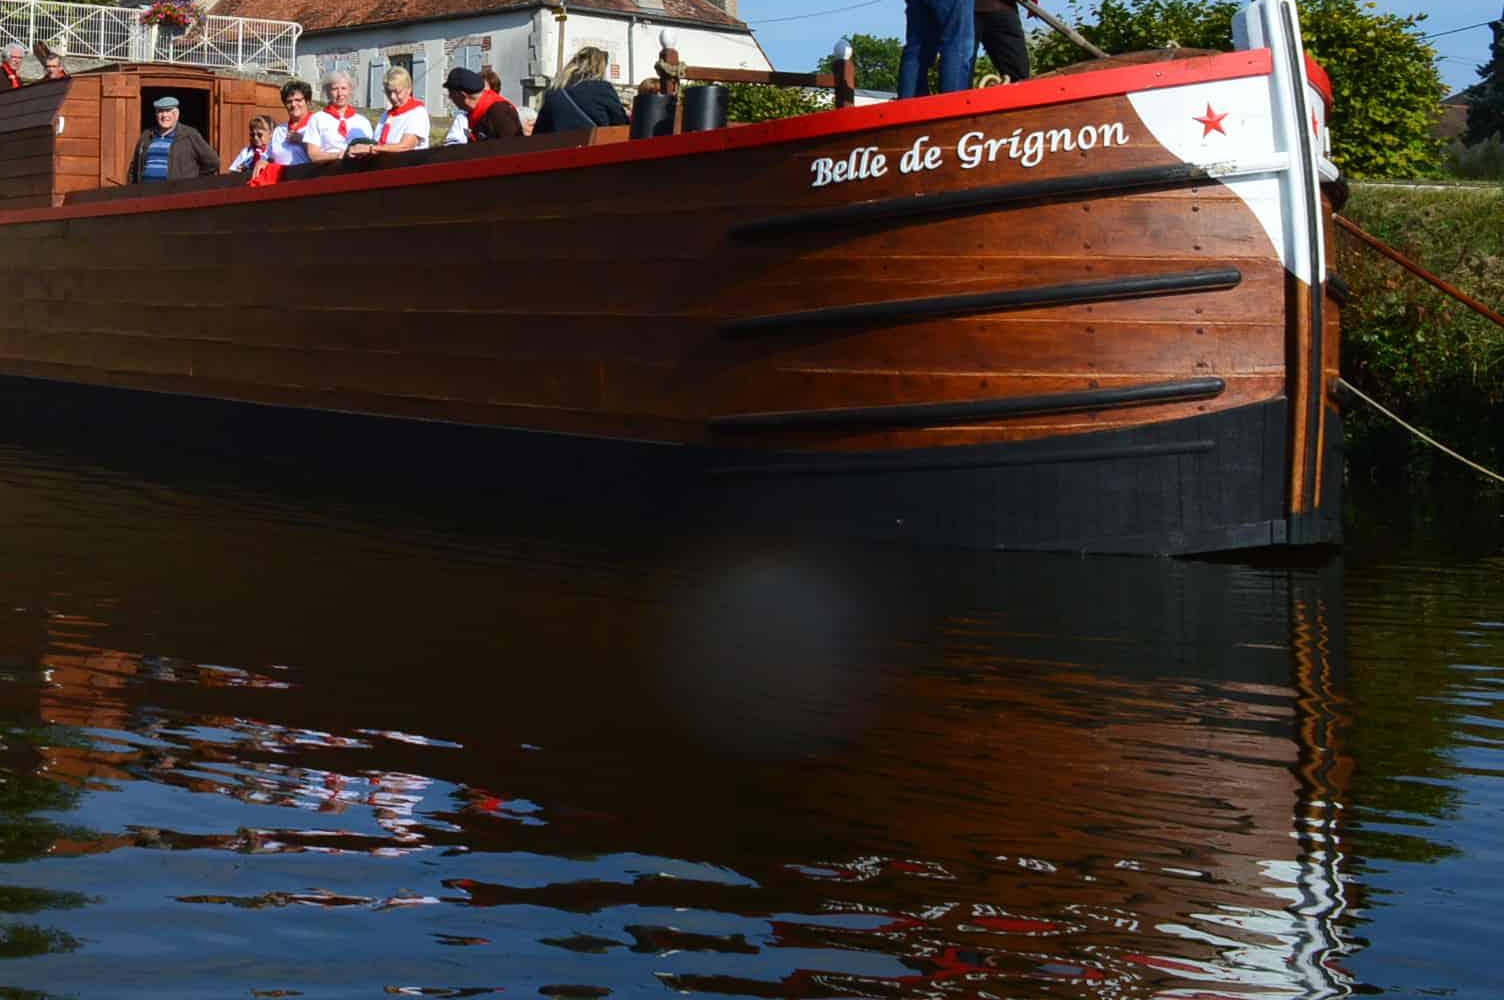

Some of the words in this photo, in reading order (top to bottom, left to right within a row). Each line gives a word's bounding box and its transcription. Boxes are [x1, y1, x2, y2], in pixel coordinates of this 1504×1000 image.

[810, 146, 888, 187] Belle
[899, 135, 943, 174] de
[956, 121, 1130, 169] Grignon
